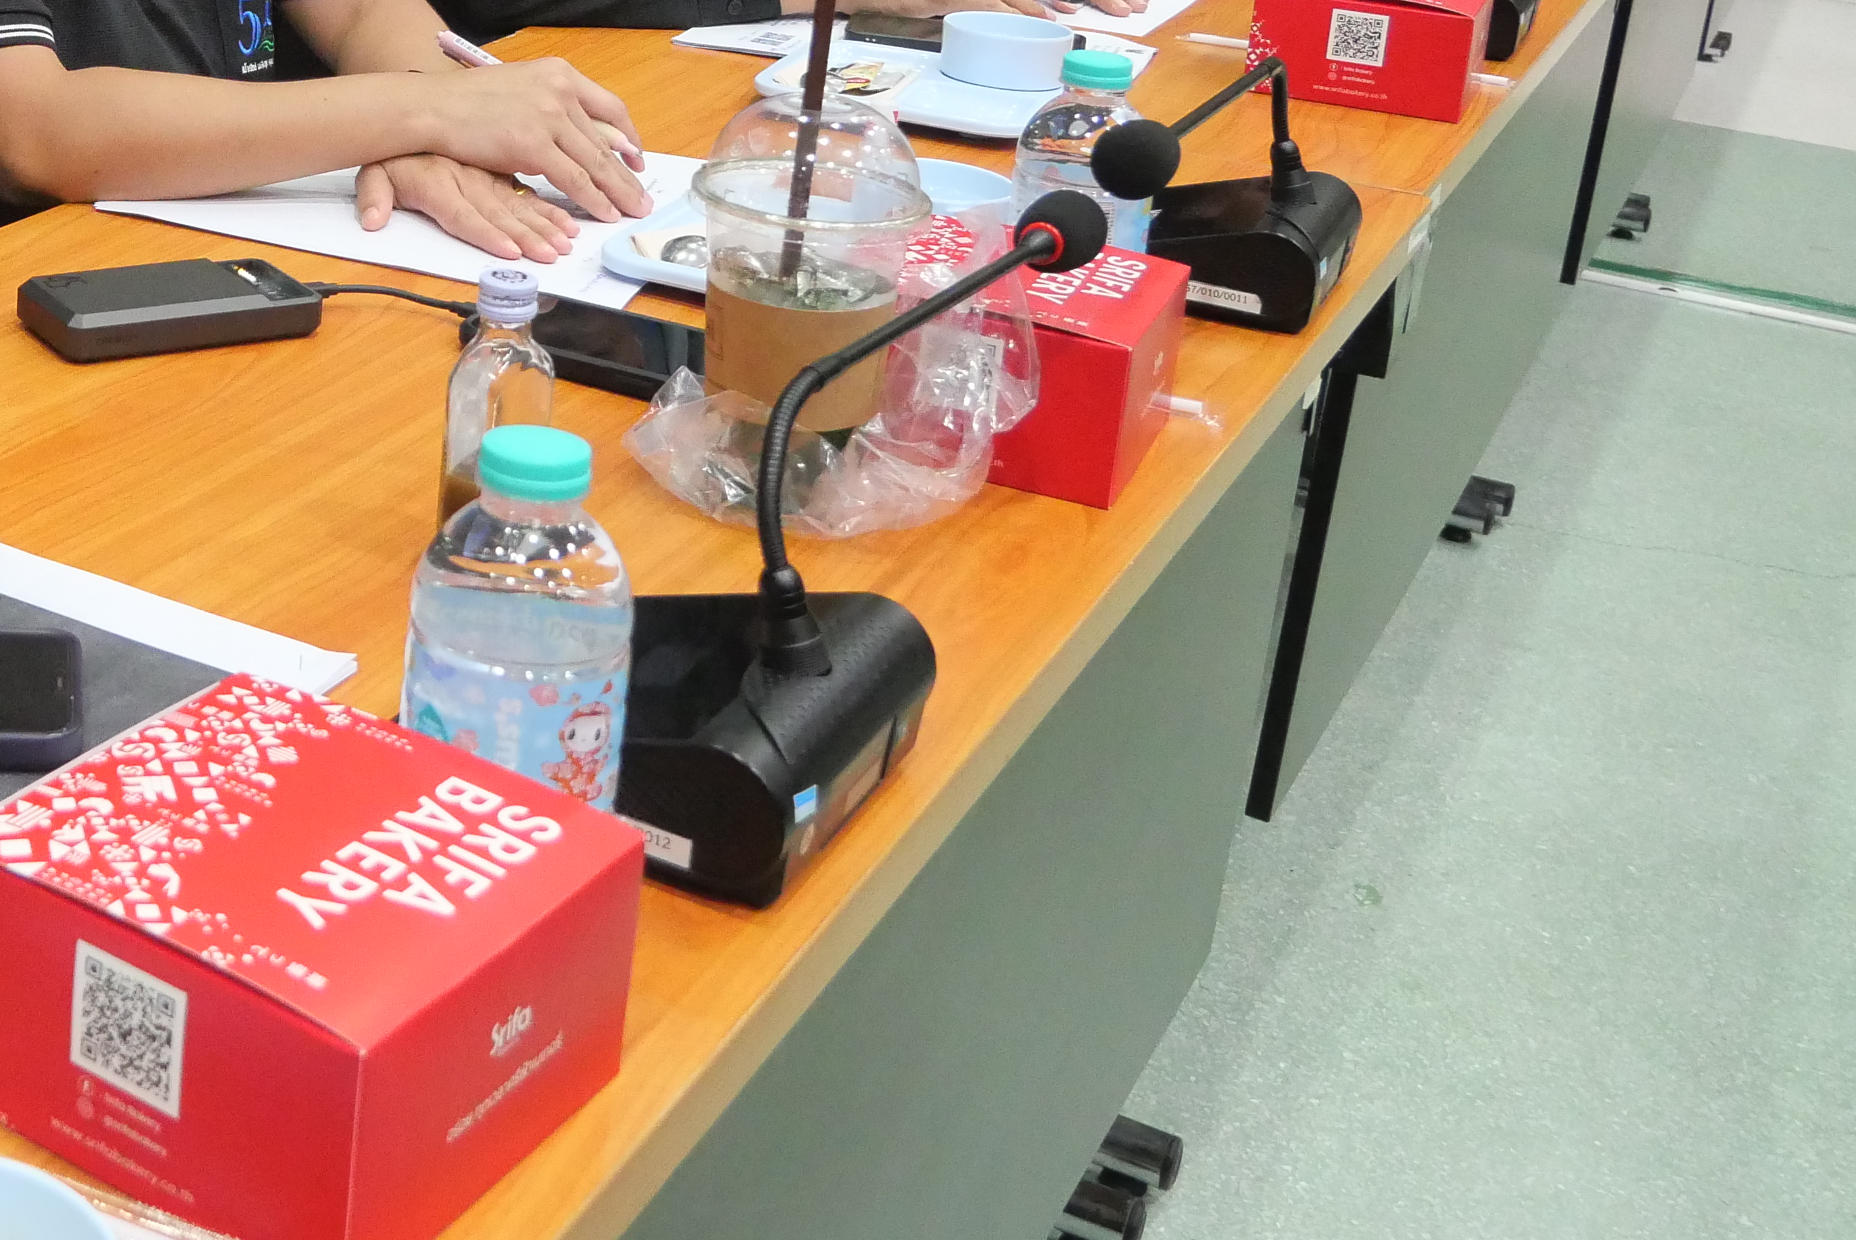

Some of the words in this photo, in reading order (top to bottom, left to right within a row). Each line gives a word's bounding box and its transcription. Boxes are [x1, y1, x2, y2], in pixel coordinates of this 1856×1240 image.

[1026, 253, 1105, 305] ERY
[1080, 255, 1148, 300] SRIFA
[275, 775, 505, 931] BAKERY
[380, 804, 564, 918] SRIFA
